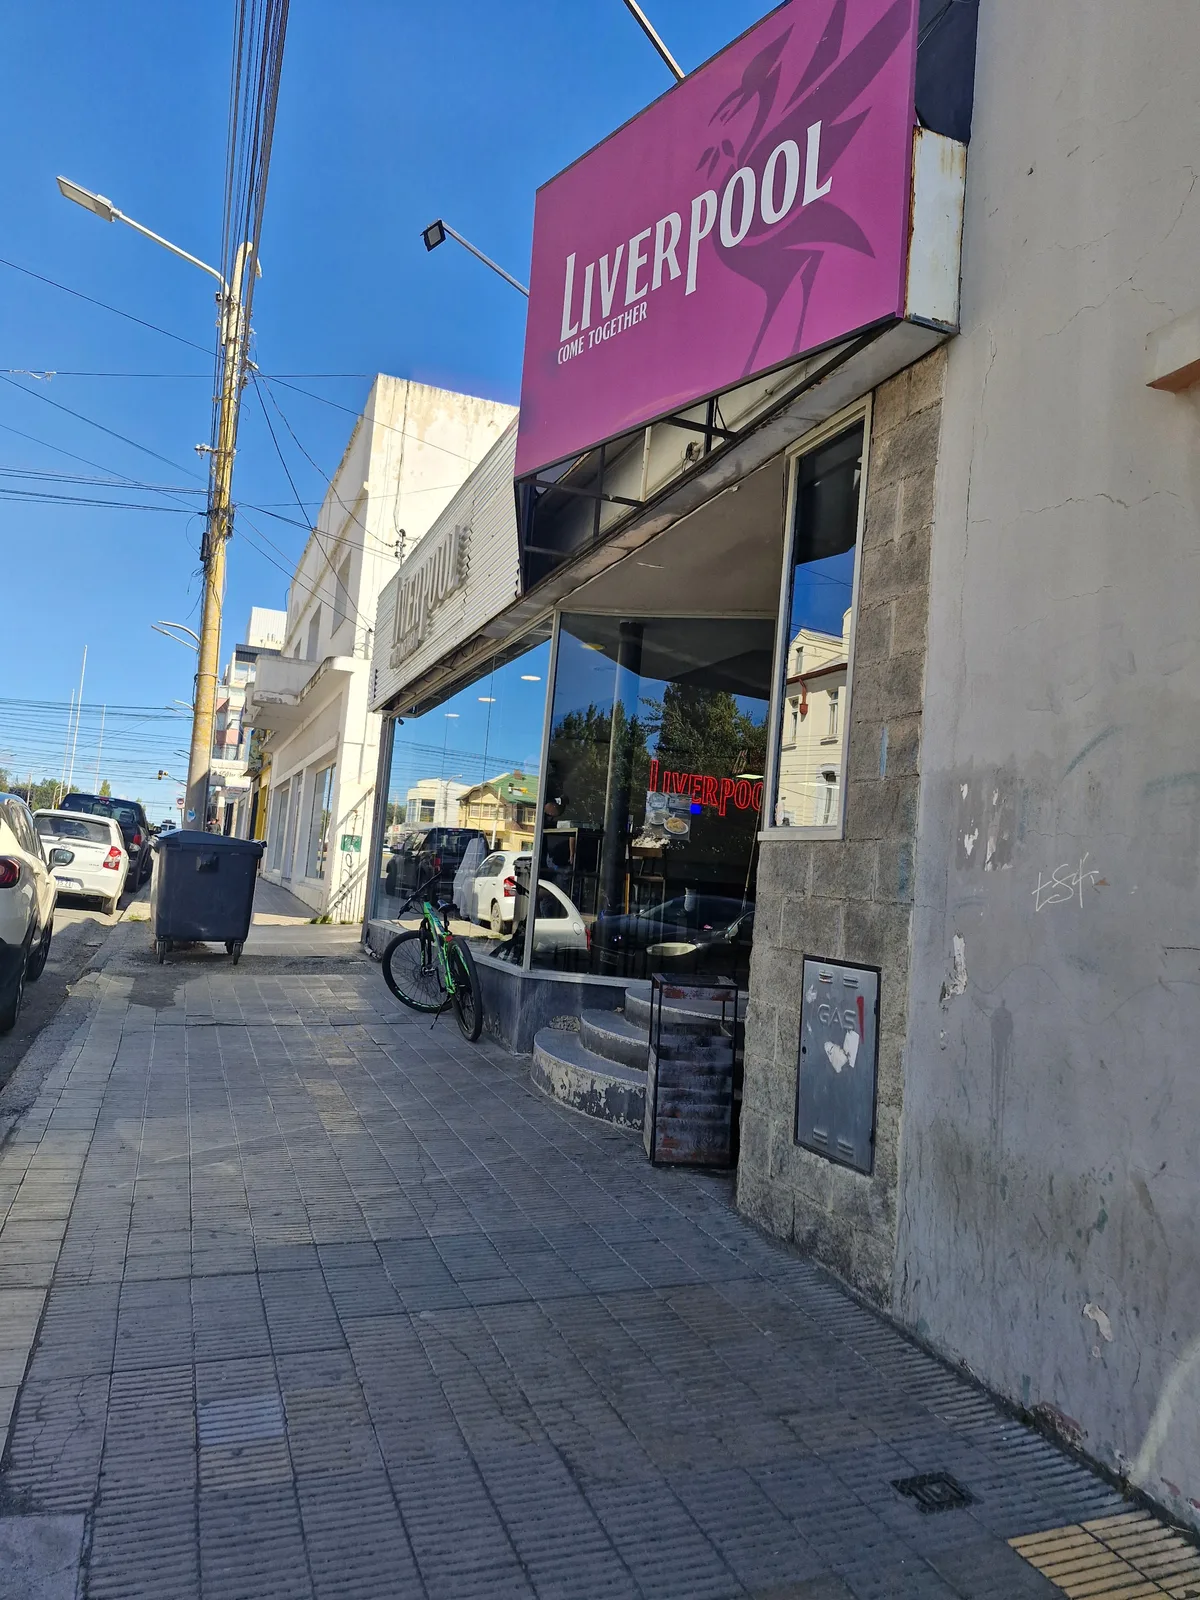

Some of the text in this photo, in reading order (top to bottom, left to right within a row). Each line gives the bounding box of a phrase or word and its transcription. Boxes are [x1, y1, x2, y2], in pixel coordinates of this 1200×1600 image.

[560, 120, 833, 343] LIVERPOOL
[557, 302, 648, 365] COME TOGETHER
[650, 759, 764, 816] LIVERPOO
[816, 1003, 857, 1032] GAS
